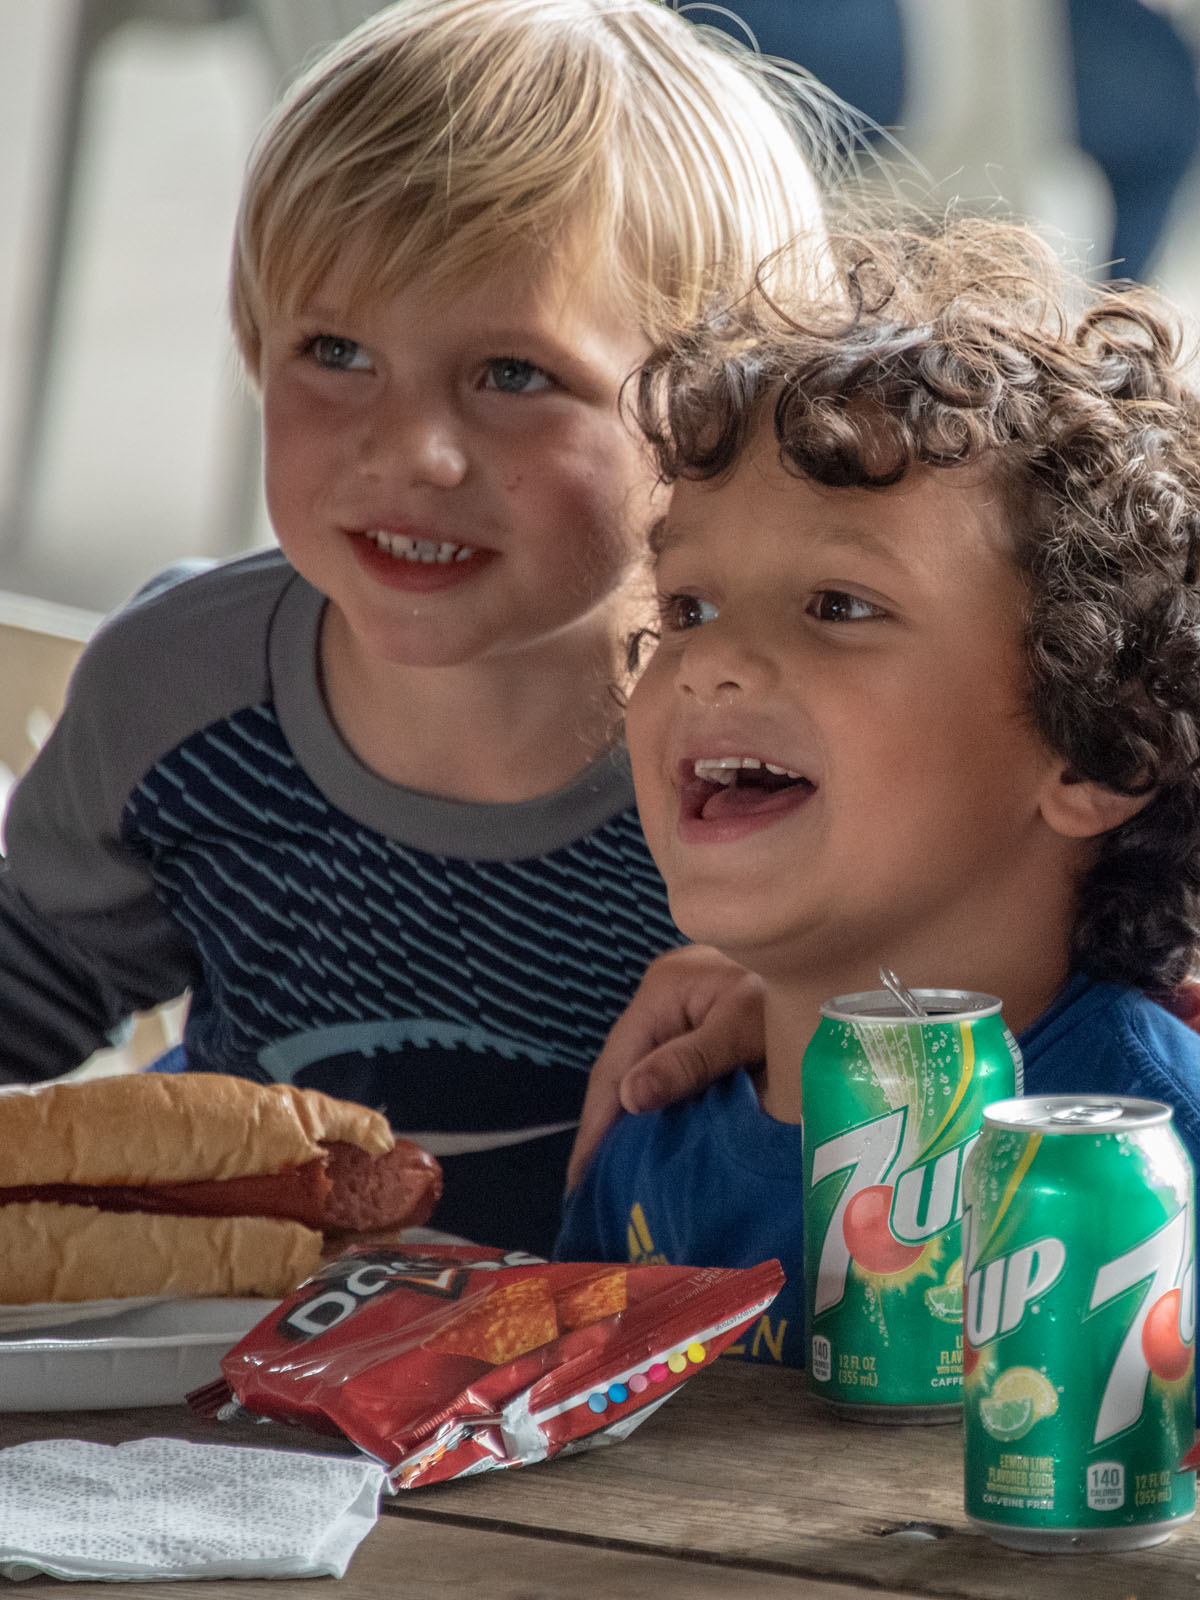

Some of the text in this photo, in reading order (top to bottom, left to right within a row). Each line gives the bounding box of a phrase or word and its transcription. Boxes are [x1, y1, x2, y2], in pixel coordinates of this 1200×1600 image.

[839, 1354, 849, 1369] 12
[850, 1355, 861, 1370] FL
[862, 1356, 876, 1371] OZ
[1091, 1469, 1120, 1488] 140
[1135, 1474, 1148, 1489] 12
[1090, 1487, 1122, 1497] CALORIES
